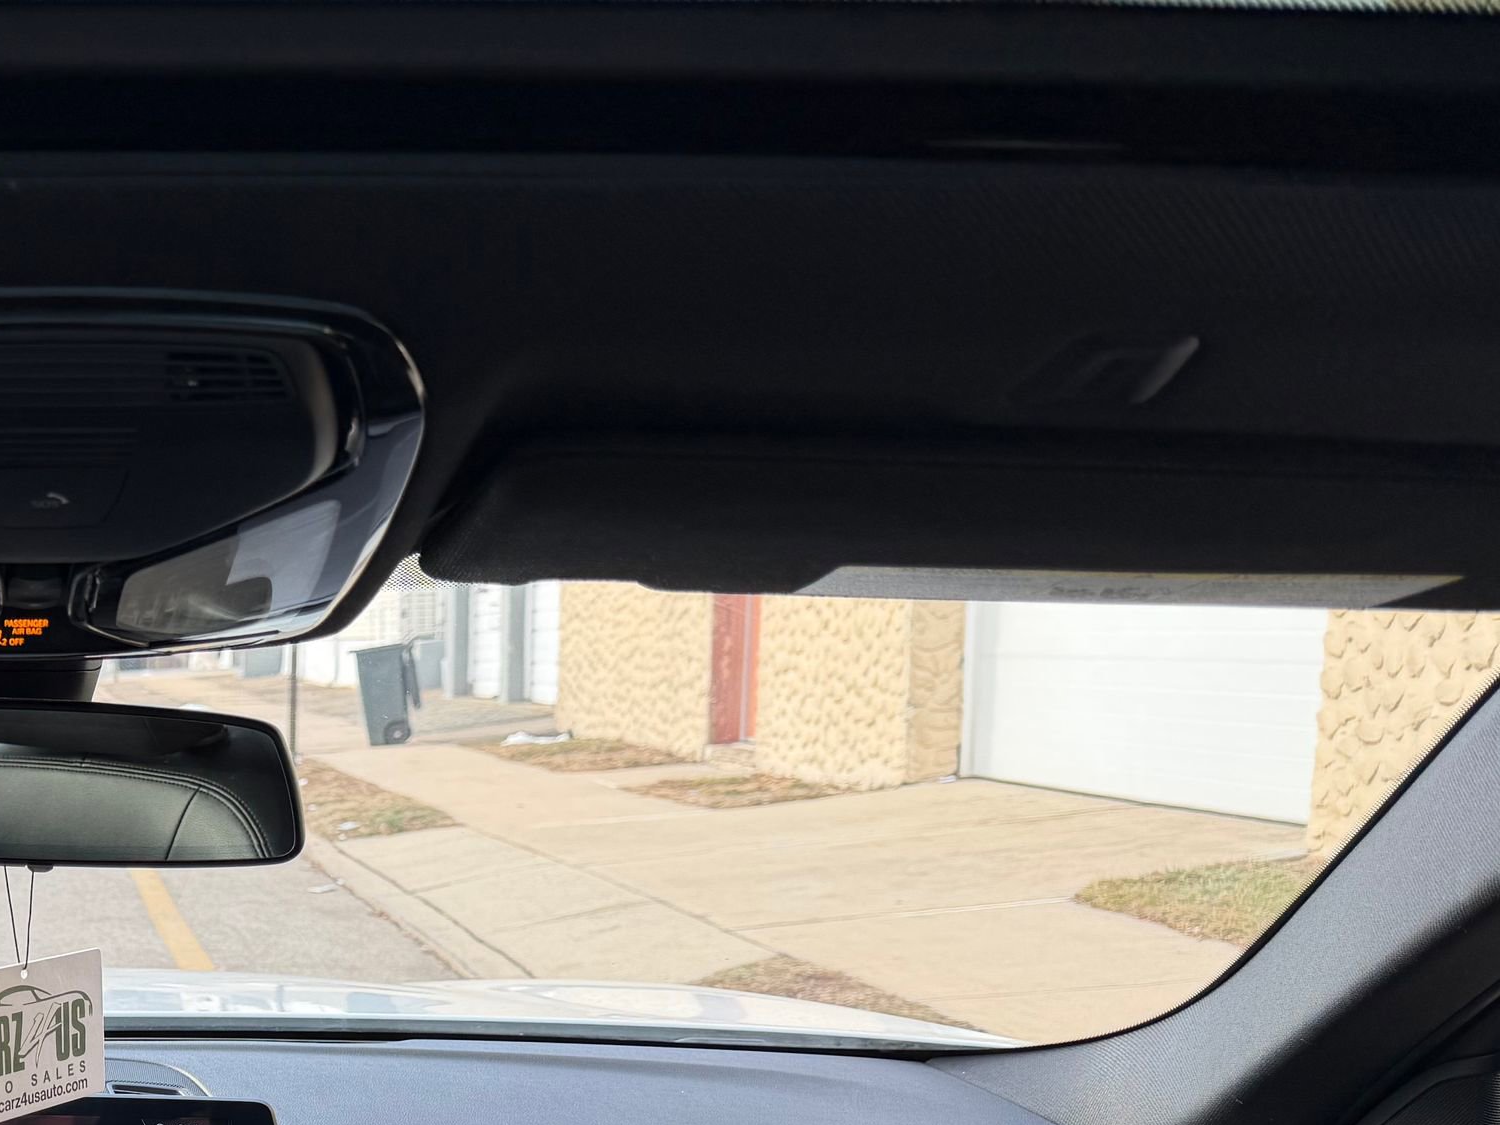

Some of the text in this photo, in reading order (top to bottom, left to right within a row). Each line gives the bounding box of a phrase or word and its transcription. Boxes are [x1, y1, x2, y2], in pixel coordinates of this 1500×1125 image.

[4, 619, 49, 627] PASSENGER
[9, 638, 24, 646] OFF
[31, 1060, 86, 1087] SALES
